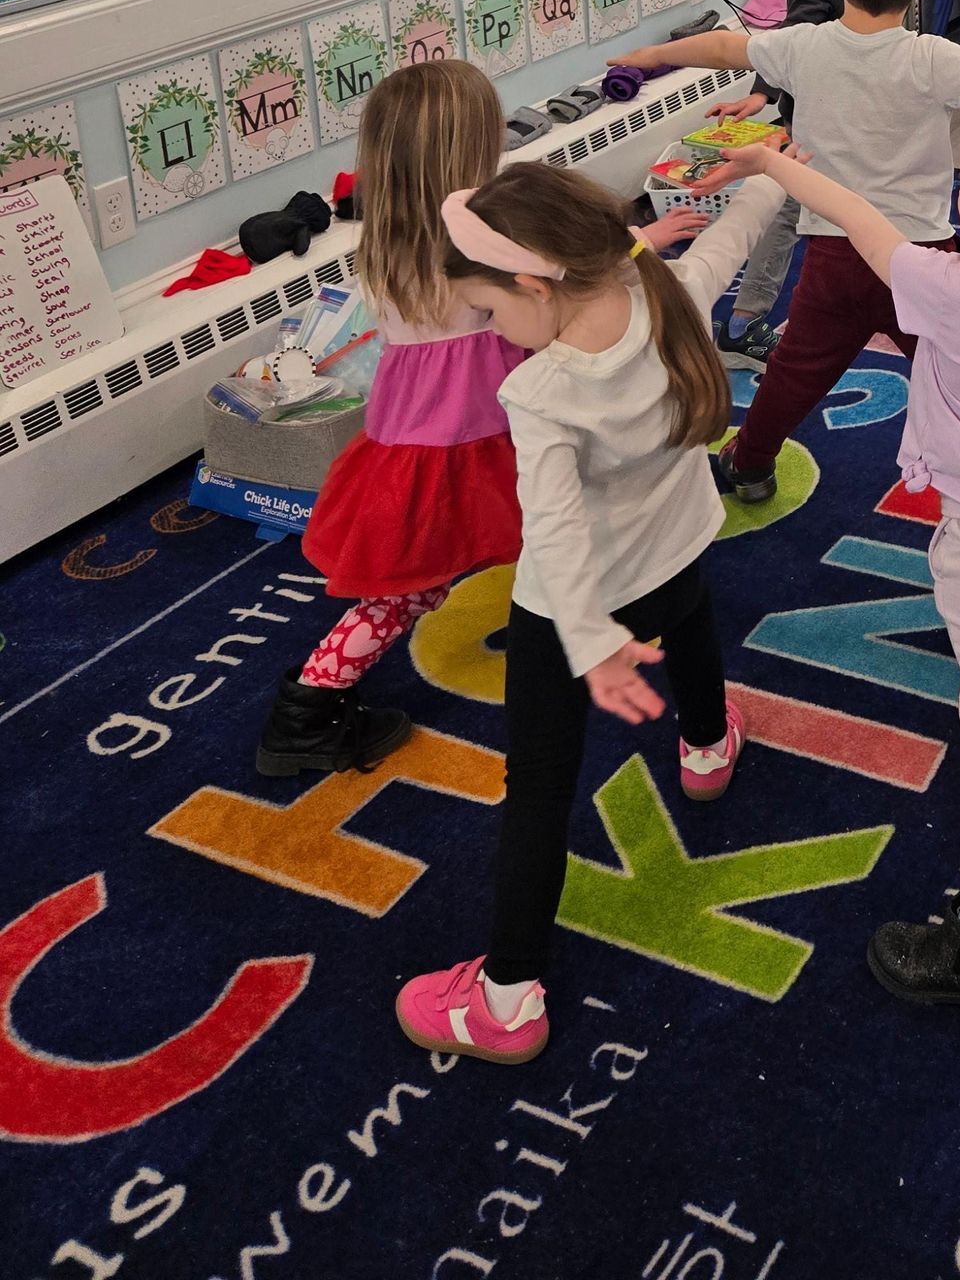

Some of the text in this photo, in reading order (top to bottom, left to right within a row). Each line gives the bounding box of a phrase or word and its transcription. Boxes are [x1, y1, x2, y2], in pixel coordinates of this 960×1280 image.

[482, 13, 513, 56] Pp
[336, 62, 373, 103] Nn
[238, 93, 301, 138] Mm
[210, 478, 235, 490] Resources
[244, 490, 312, 519] Chick Life Cycl
[261, 506, 289, 519] Exploration
